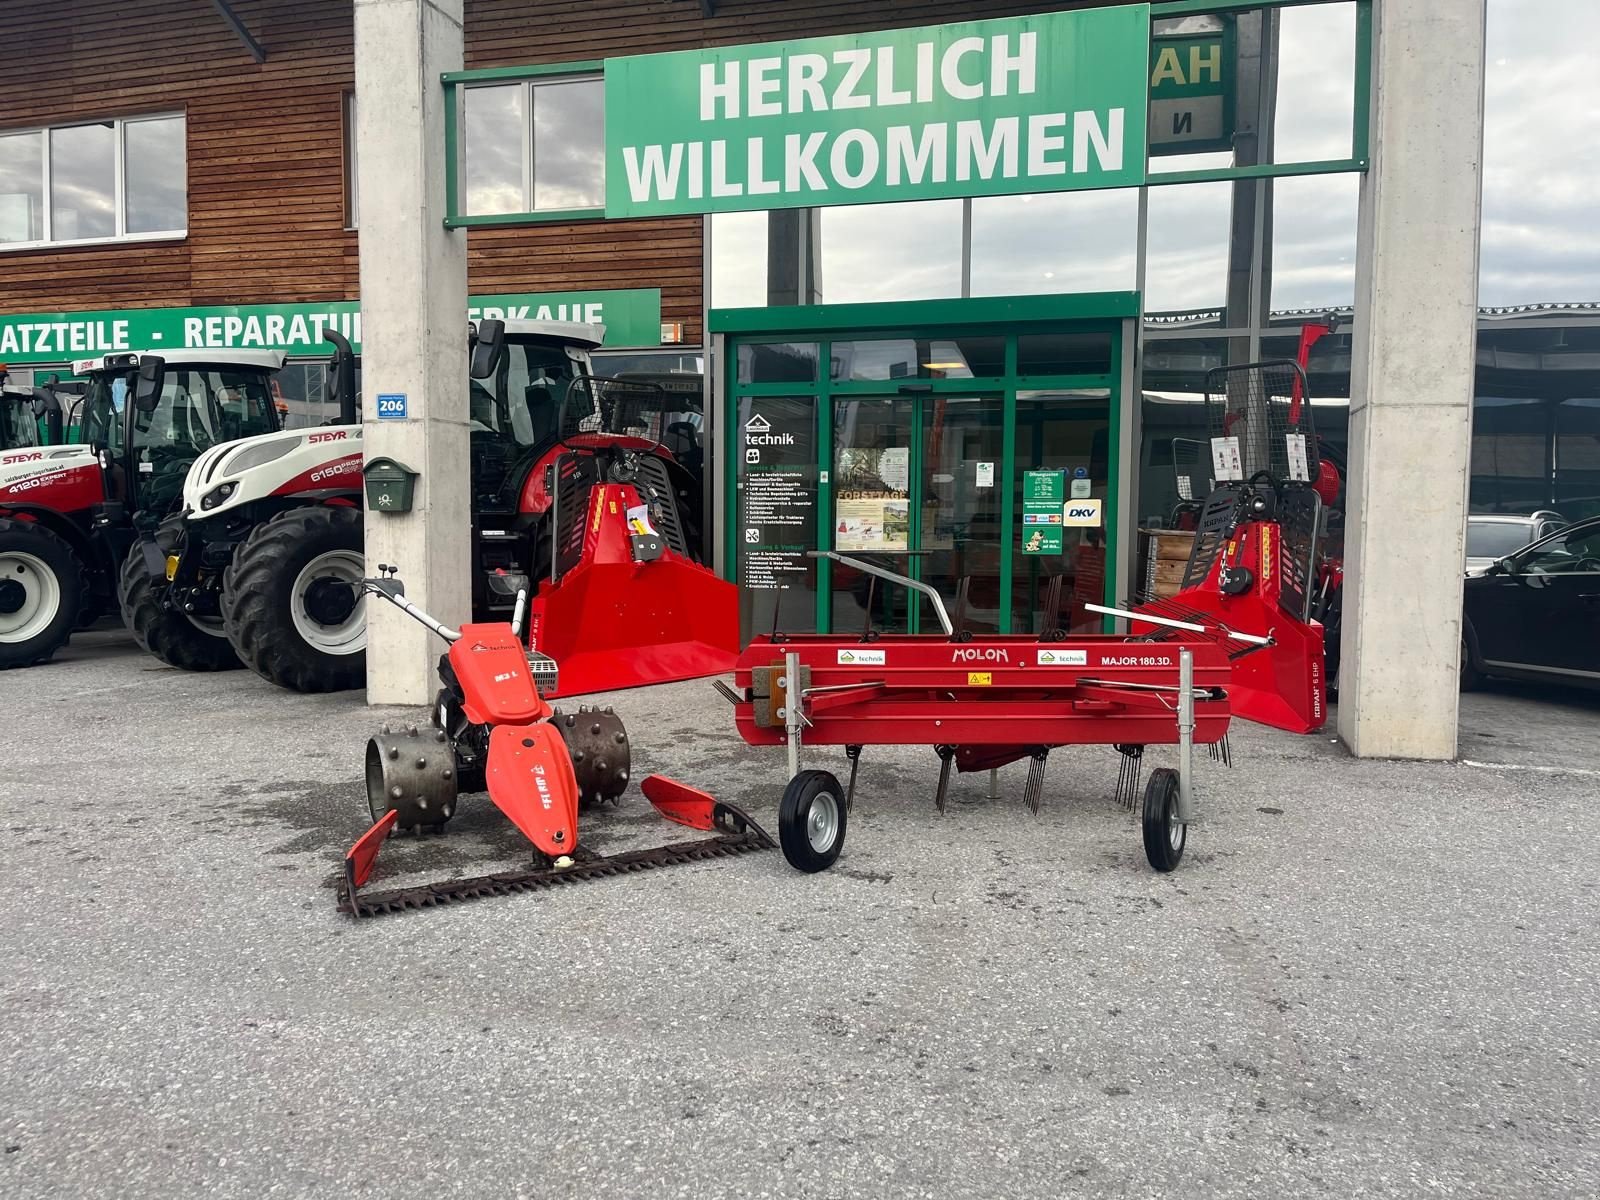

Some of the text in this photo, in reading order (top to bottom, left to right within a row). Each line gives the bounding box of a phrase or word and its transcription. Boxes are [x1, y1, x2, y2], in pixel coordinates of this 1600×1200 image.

[700, 31, 1037, 121] HERZLICH
[623, 107, 1125, 202] WILLKOMMEN
[379, 400, 404, 412] 206
[308, 431, 347, 444] STEYR
[745, 433, 794, 445] technik
[3, 452, 43, 465] STEYR
[310, 464, 343, 482] 6150
[9, 472, 67, 494] 4120 EXPERT
[1069, 509, 1096, 517] DKV
[858, 655, 883, 663] technik
[952, 648, 1009, 663] MOLON
[1059, 654, 1085, 663] technik
[1101, 656, 1138, 666] MAJOR
